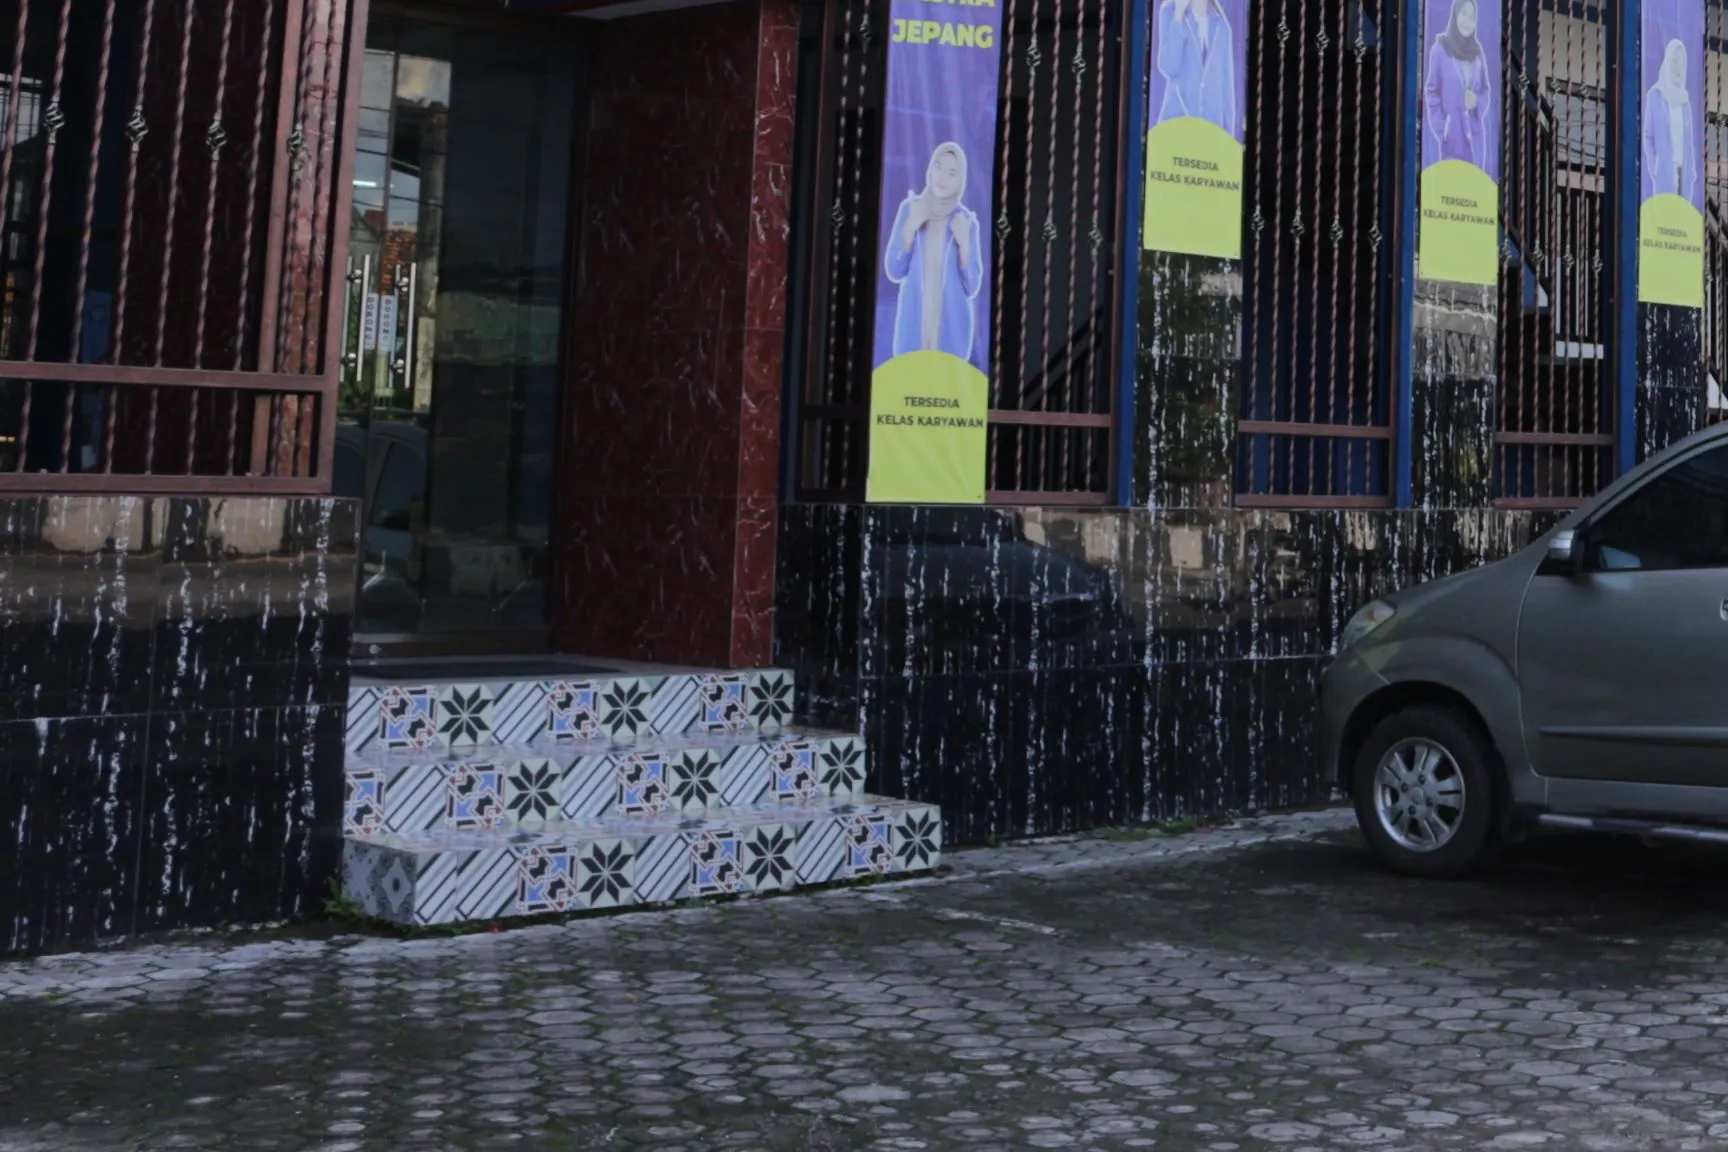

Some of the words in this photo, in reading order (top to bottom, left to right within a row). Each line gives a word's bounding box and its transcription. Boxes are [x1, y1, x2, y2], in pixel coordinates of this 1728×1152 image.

[892, 19, 993, 48] JEPANG
[1172, 156, 1219, 172] TERSEDIA
[1150, 171, 1181, 184] KELAS
[1184, 176, 1240, 191] KARYAWAN
[1441, 196, 1478, 208] TERSEDIA
[1423, 208, 1448, 220] KELAS
[1450, 212, 1495, 226] KARYAWAN
[904, 396, 960, 409] TERSEDIA
[877, 414, 914, 426] KELAS
[917, 416, 983, 429] KARYAWAN
